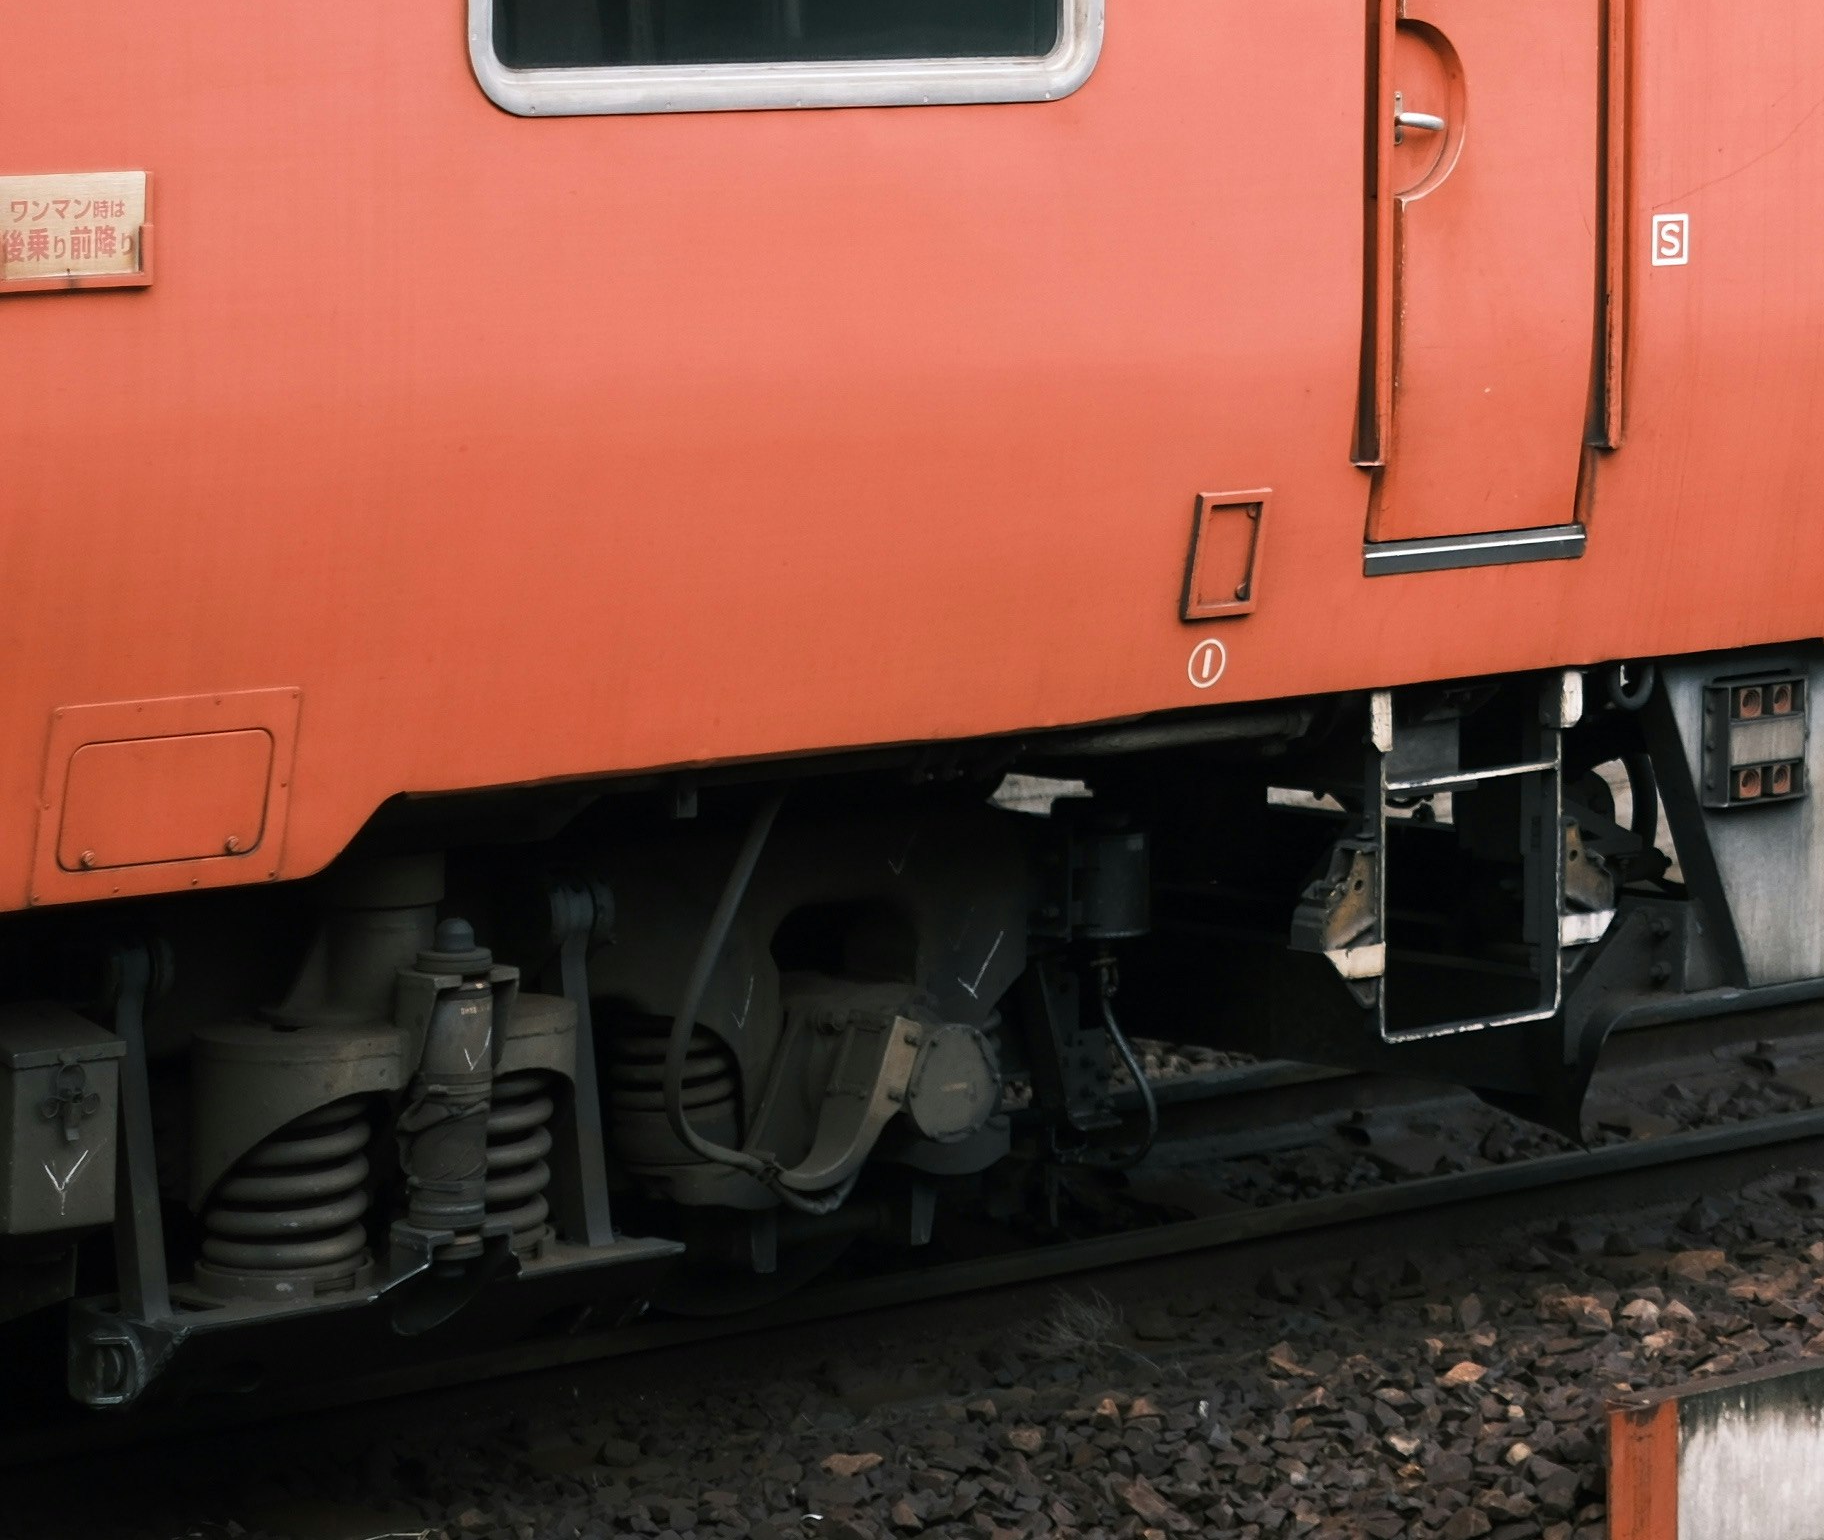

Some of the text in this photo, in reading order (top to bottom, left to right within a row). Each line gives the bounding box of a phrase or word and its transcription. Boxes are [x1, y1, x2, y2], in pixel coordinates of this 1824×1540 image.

[10, 198, 126, 223] ワンマン時は
[3, 225, 134, 263] 後乗り前降り
[1661, 223, 1680, 256] S
